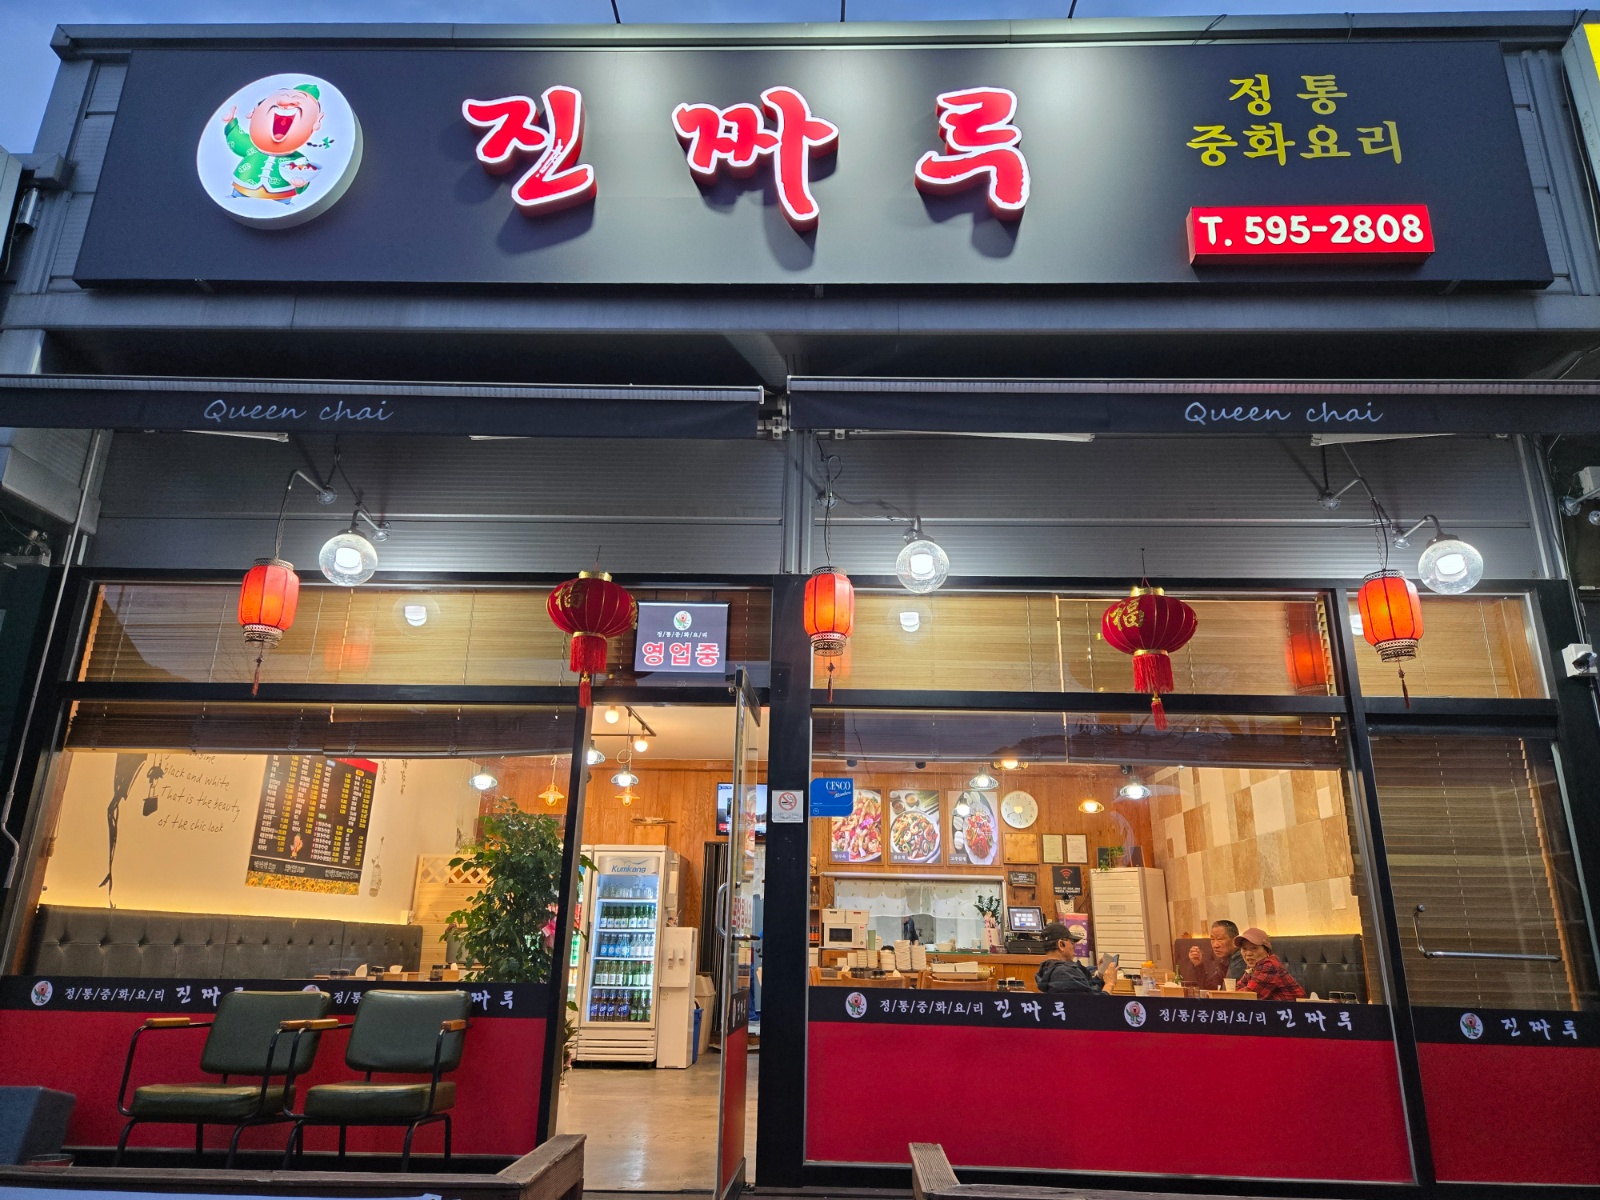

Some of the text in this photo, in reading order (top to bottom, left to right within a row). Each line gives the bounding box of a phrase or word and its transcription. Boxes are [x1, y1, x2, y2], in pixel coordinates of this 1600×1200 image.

[1229, 74, 1348, 117] 정통
[1186, 120, 1403, 166] 중화요리
[1199, 213, 1424, 247] T. 595-2808
[203, 398, 394, 423] Queen chai
[1184, 401, 1384, 426] Queen chai
[641, 641, 720, 667] 영업중
[164, 762, 230, 791] black and white
[825, 780, 851, 791] CESCO
[161, 786, 241, 823] That is the beauty
[157, 813, 224, 833] of the chic look
[879, 999, 984, 1016] 정/통/중/화/요/리
[1159, 1008, 1268, 1026] 정/통/중/화/요/리
